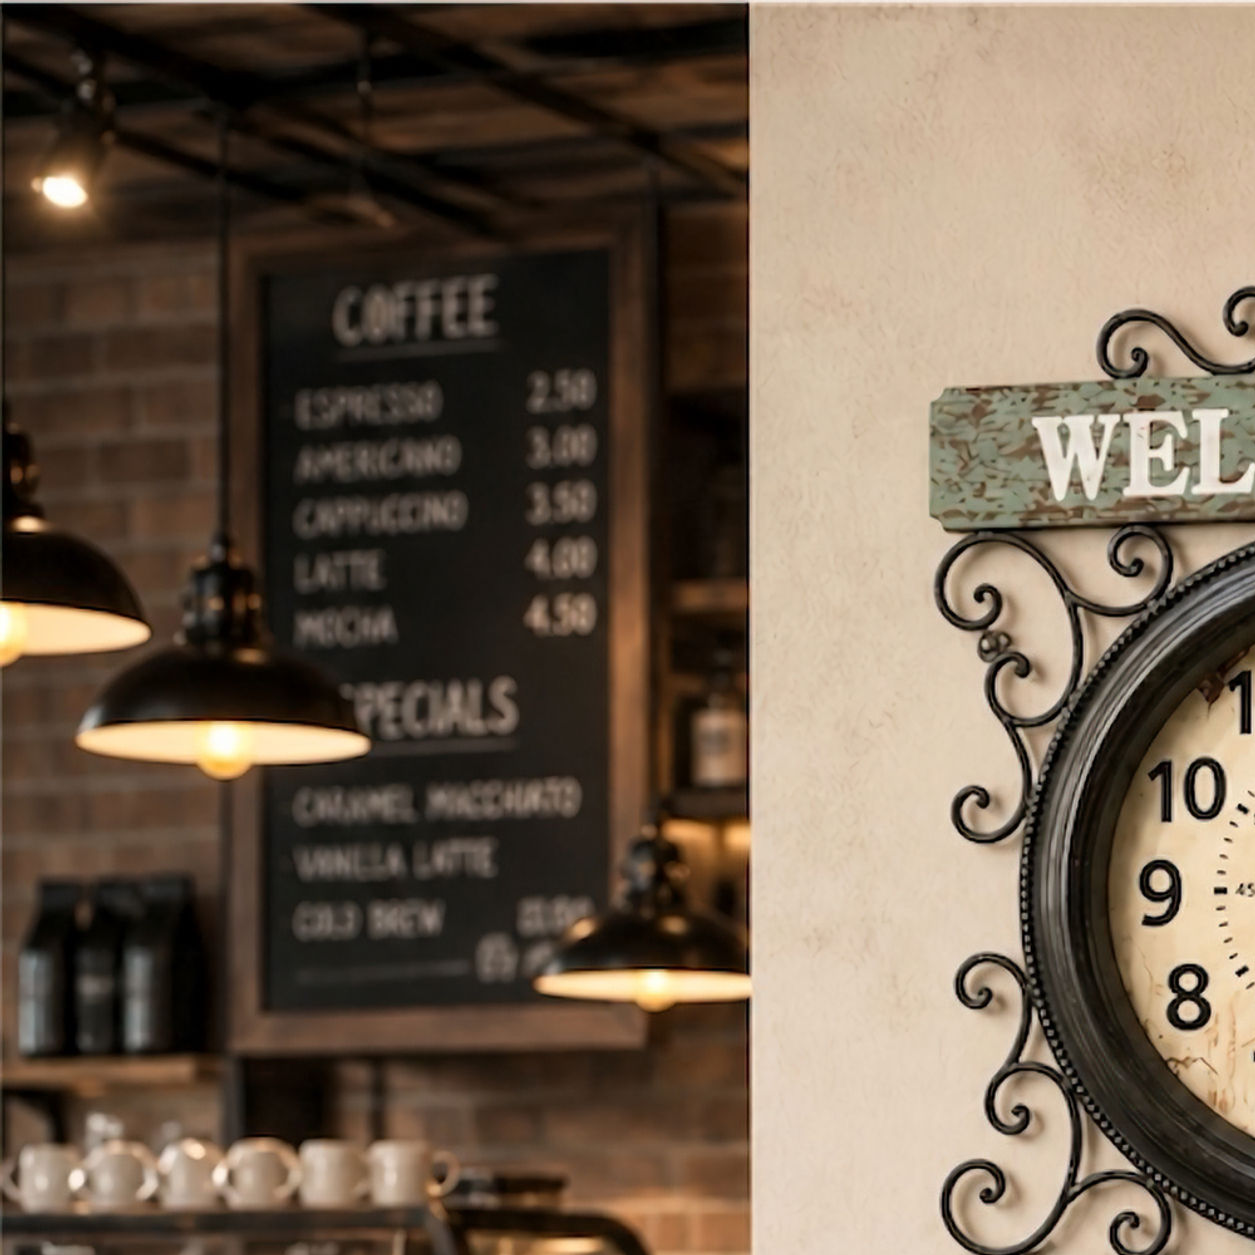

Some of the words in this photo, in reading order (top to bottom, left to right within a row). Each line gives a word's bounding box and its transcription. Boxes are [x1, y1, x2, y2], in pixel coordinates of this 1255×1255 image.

[333, 274, 499, 346] COFFEE
[295, 380, 444, 429] ESPRESSO
[294, 549, 387, 594] LATTE
[1148, 757, 1226, 822] 10
[413, 838, 498, 879] LATTE
[1139, 859, 1182, 926] 9
[1235, 883, 1255, 898] 45
[369, 900, 445, 938] BREW
[1167, 964, 1212, 1030] 8
